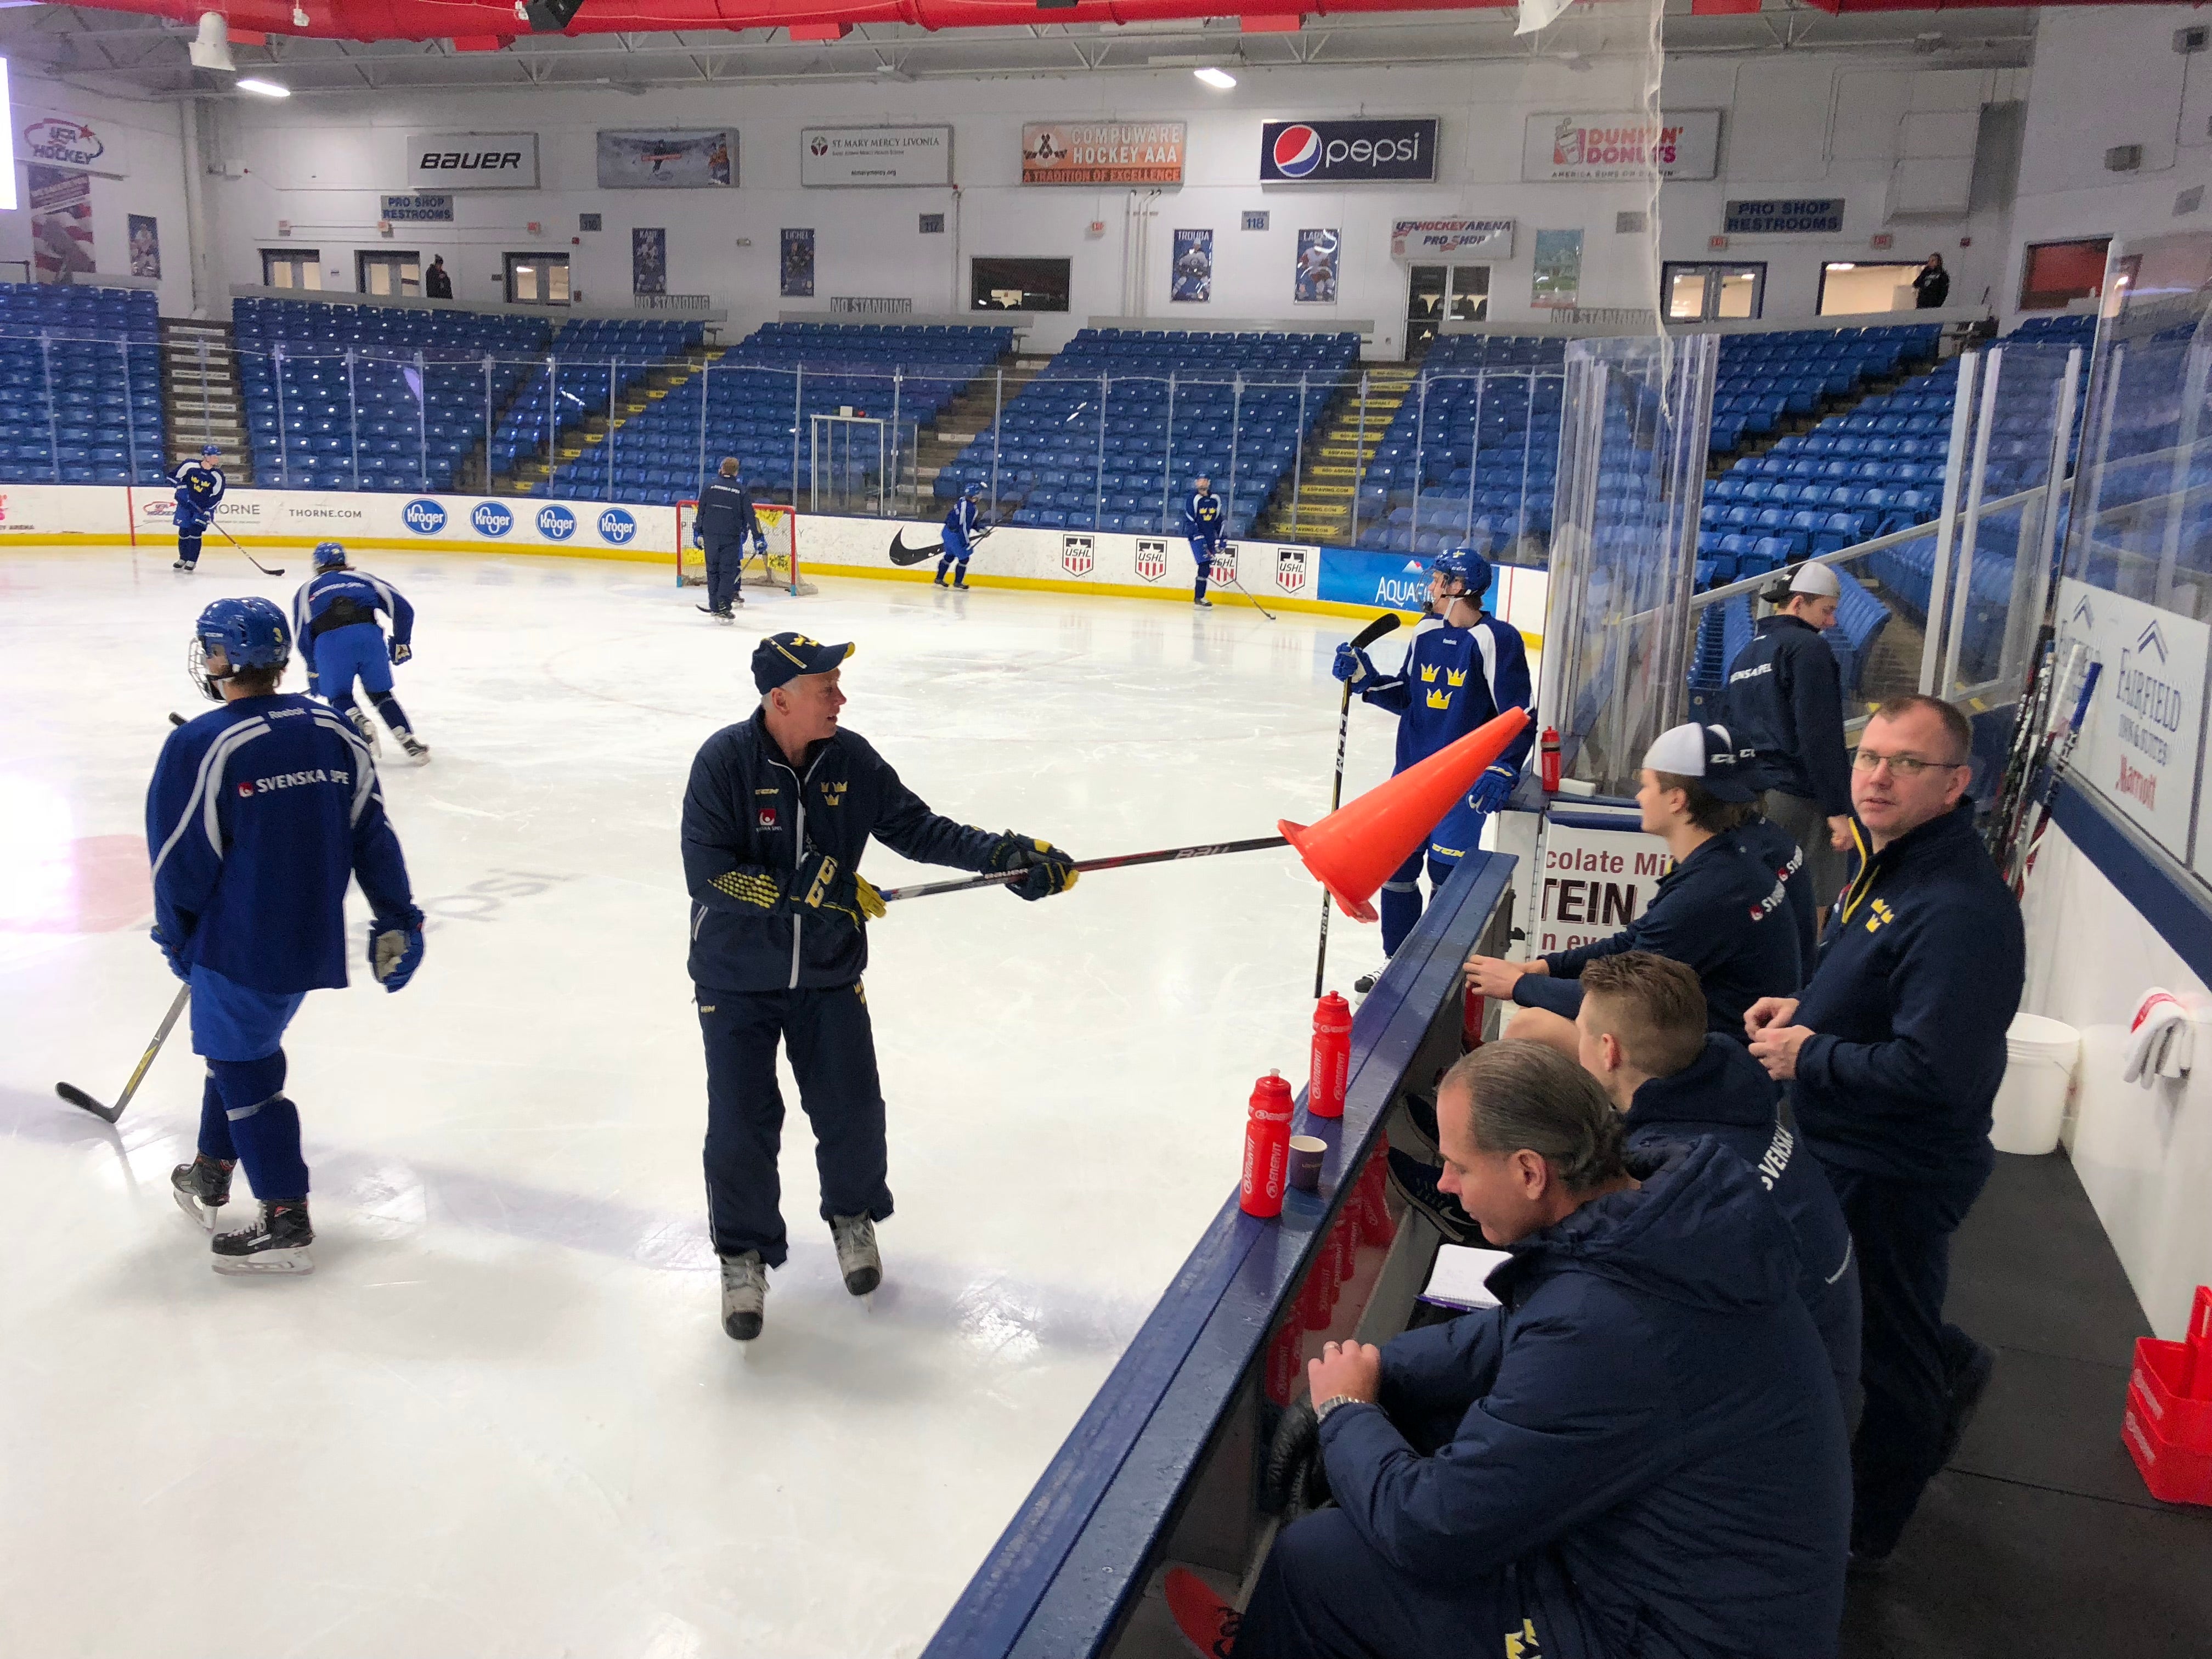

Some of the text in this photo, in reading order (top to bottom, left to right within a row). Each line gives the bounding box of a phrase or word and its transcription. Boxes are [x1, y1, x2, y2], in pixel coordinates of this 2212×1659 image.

[844, 139, 867, 148] MARY
[871, 138, 900, 147] MERCY
[903, 137, 940, 146] LIVONIA
[1071, 127, 1180, 145] COMPUWARE
[33, 144, 91, 165] HOCKEY
[1073, 145, 1177, 164] HOCKEY AAA
[1325, 132, 1420, 168] pepsi
[420, 152, 521, 170] BAUER
[1023, 169, 1181, 183] A TRADITION OF EXCELLENCE
[388, 197, 445, 207] PRO SHOP
[1737, 202, 1831, 215] PRO SHOP
[382, 209, 452, 219] RESTROOMS
[1727, 217, 1838, 231] RESTROOMS
[1423, 235, 1448, 246] PRO
[654, 296, 710, 309] STANDING
[831, 298, 912, 313] NO STANDING
[289, 509, 362, 518] THORNE.COM
[407, 504, 444, 531] Kroger
[475, 506, 511, 533] Kroger
[540, 509, 574, 538] Kroger
[601, 512, 634, 541] Kroger
[1065, 548, 1092, 558] USHL
[1138, 552, 1164, 563] USHL
[1279, 562, 1304, 573] USHL
[1336, 713, 1348, 772] CCM
[255, 769, 328, 793] SVENSKA
[1546, 848, 1672, 877] colate Mi
[1269, 1141, 1282, 1181] ENERVIT
